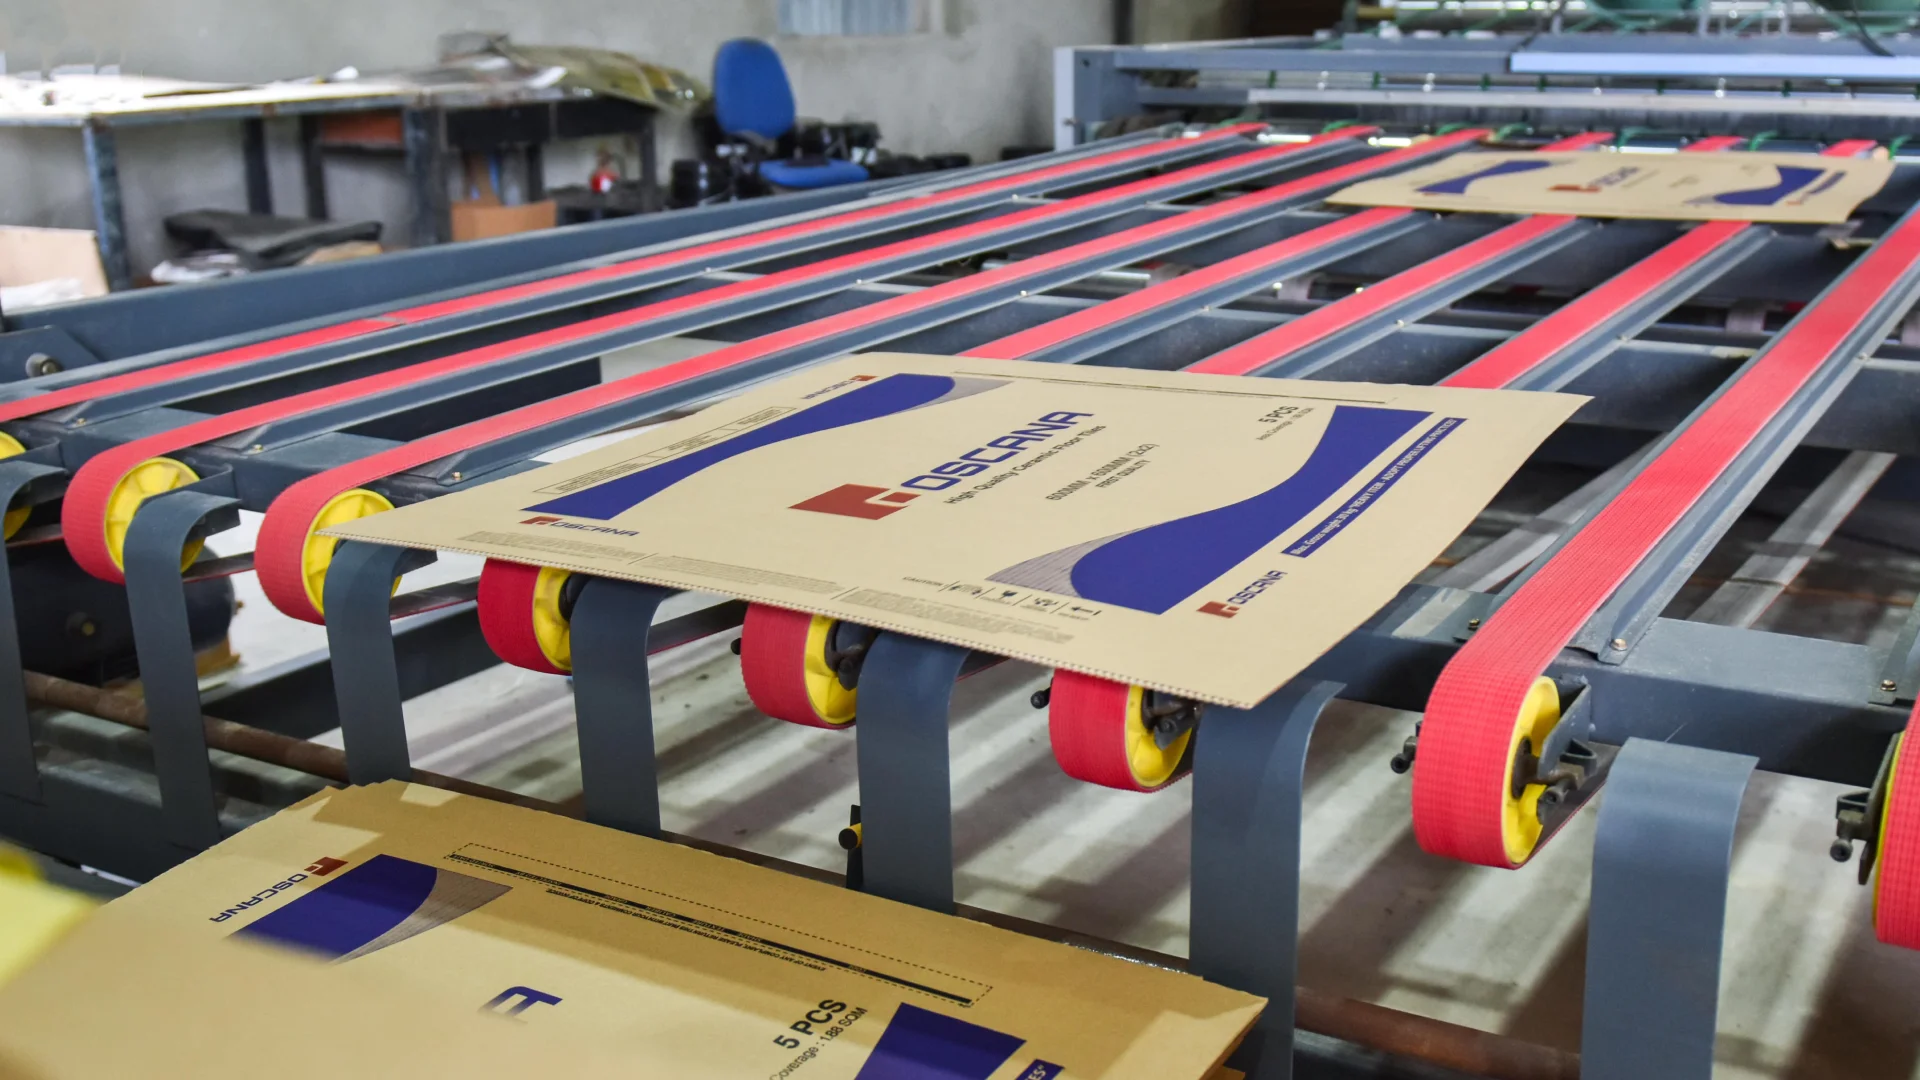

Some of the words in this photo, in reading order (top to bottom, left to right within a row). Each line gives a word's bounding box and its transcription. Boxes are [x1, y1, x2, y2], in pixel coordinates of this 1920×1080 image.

[1265, 406, 1299, 419] PCS
[901, 411, 1094, 491] OSCANA
[1126, 443, 1160, 457] (2x2)
[943, 491, 979, 504] High
[973, 470, 1019, 493] Quality
[1013, 448, 1060, 472] Ceramic
[1053, 437, 1084, 451] Floor
[1077, 425, 1106, 437] Tiles
[1115, 459, 1151, 478] QUALITY
[550, 522, 640, 536] OSCANA
[1227, 569, 1288, 605] OSCANA
[208, 873, 309, 923] OSCANA
[692, 929, 719, 942] RETURN
[716, 936, 743, 948] PLEASE
[779, 955, 796, 963] ANY
[804, 962, 827, 972] EVENT
[773, 1034, 800, 1049] 5
[790, 999, 847, 1035] PCS
[838, 1007, 868, 1027] SQM
